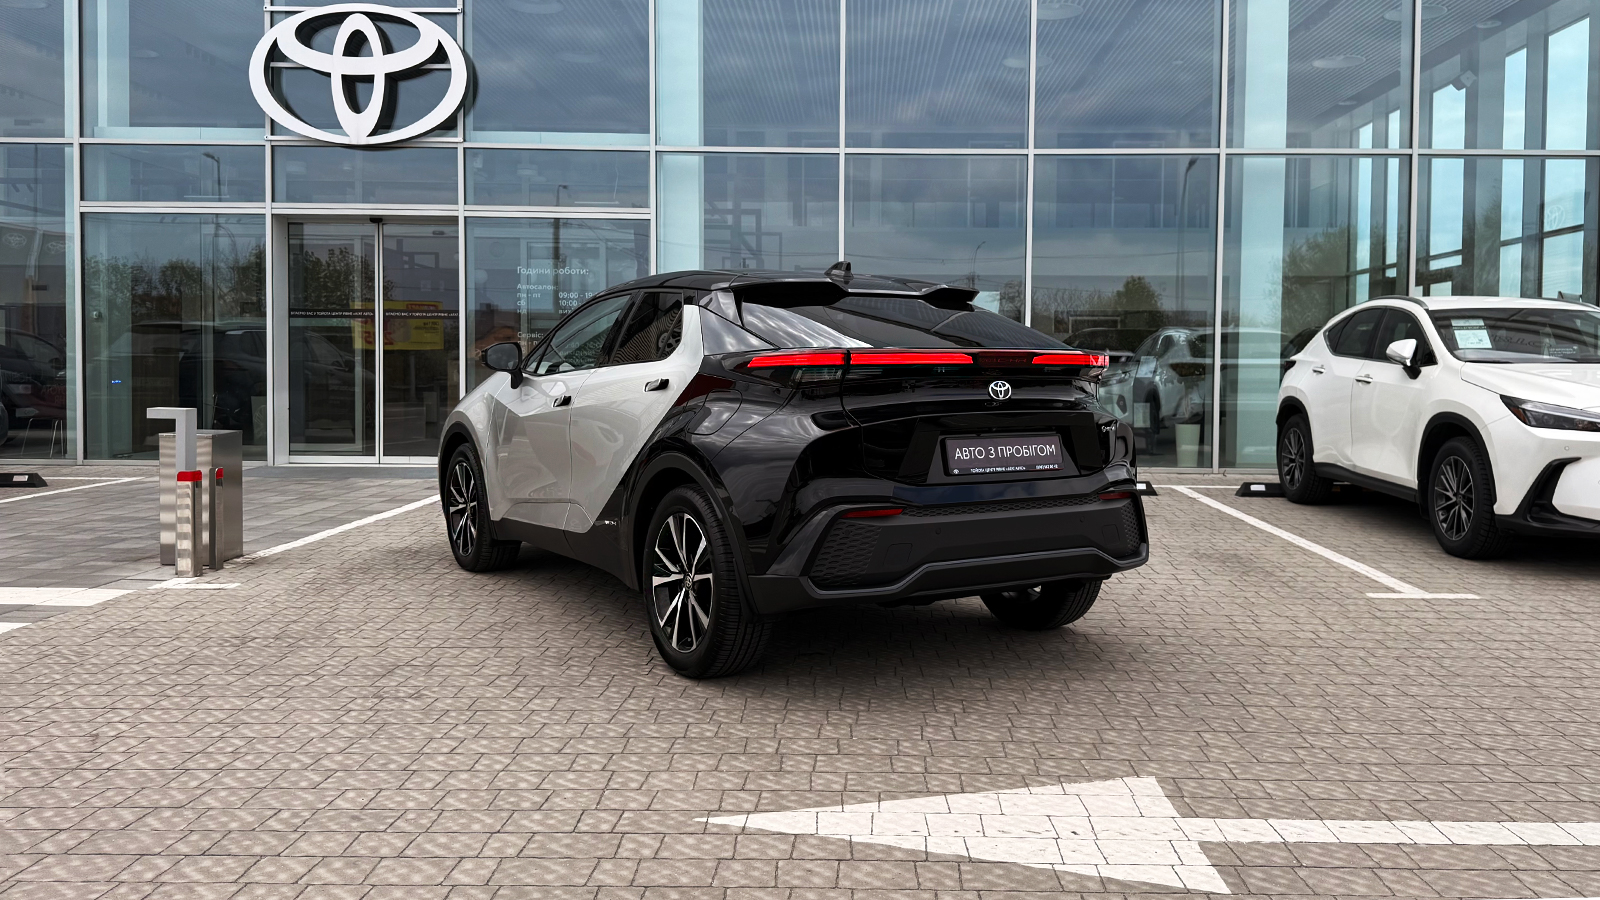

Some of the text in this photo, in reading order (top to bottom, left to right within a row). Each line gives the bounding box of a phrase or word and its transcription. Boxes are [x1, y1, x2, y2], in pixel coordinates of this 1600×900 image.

[517, 267, 589, 275] Години роботи:
[955, 447, 985, 460] АВТО
[998, 444, 1056, 458] ПРОБІГОМ
